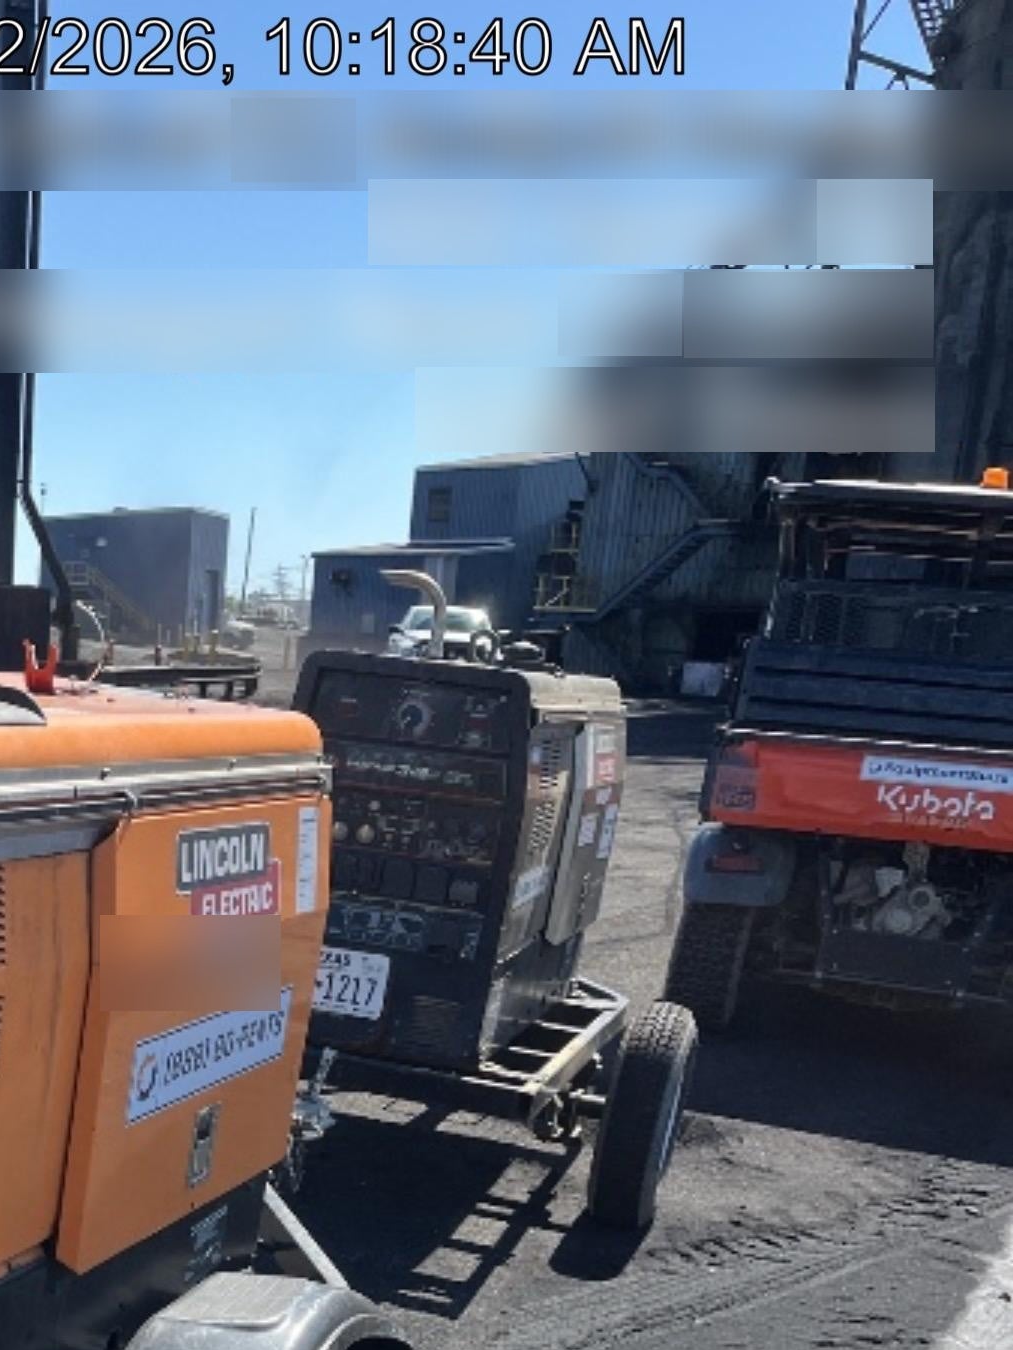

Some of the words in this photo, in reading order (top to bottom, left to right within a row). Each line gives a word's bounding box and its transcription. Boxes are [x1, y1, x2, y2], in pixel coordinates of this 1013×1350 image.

[877, 784, 995, 820] Kubota
[181, 832, 265, 883] LINCOLN
[202, 880, 274, 915] ELECTRIC
